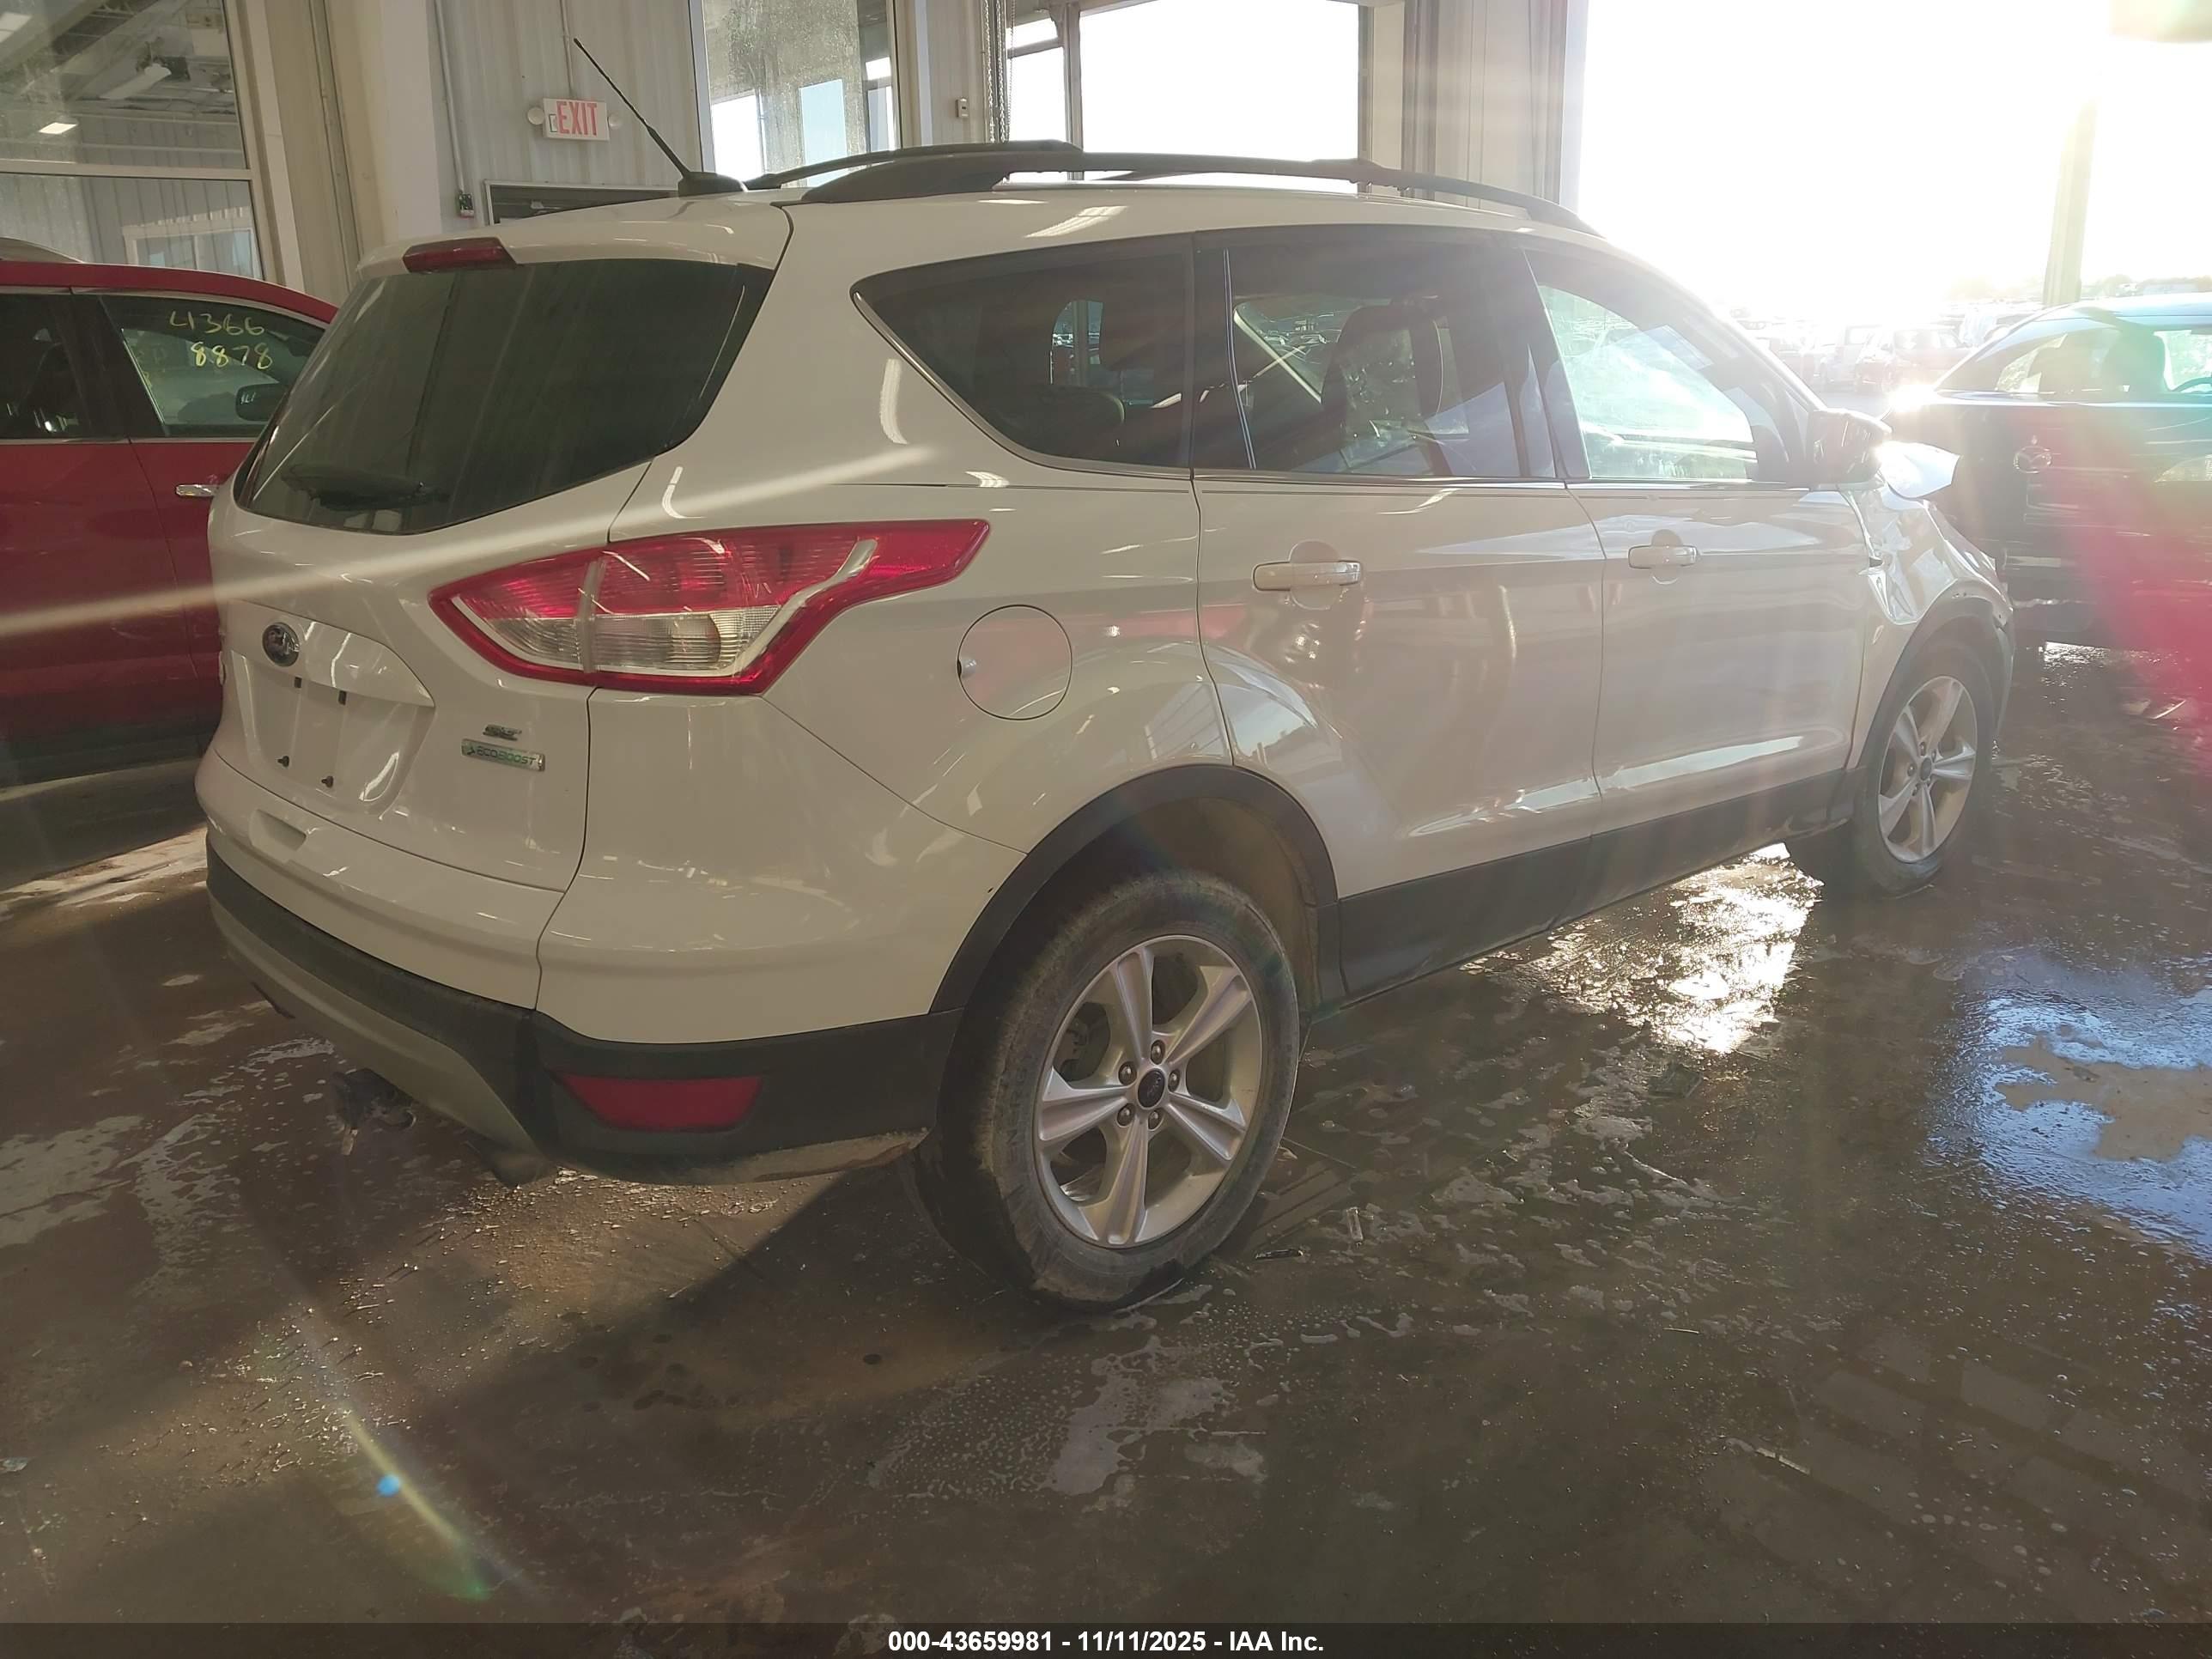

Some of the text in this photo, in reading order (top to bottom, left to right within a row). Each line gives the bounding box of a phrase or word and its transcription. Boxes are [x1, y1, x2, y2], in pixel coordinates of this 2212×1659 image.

[556, 101, 597, 136] EXIT
[169, 311, 265, 336] 4366
[191, 341, 273, 370] 8878
